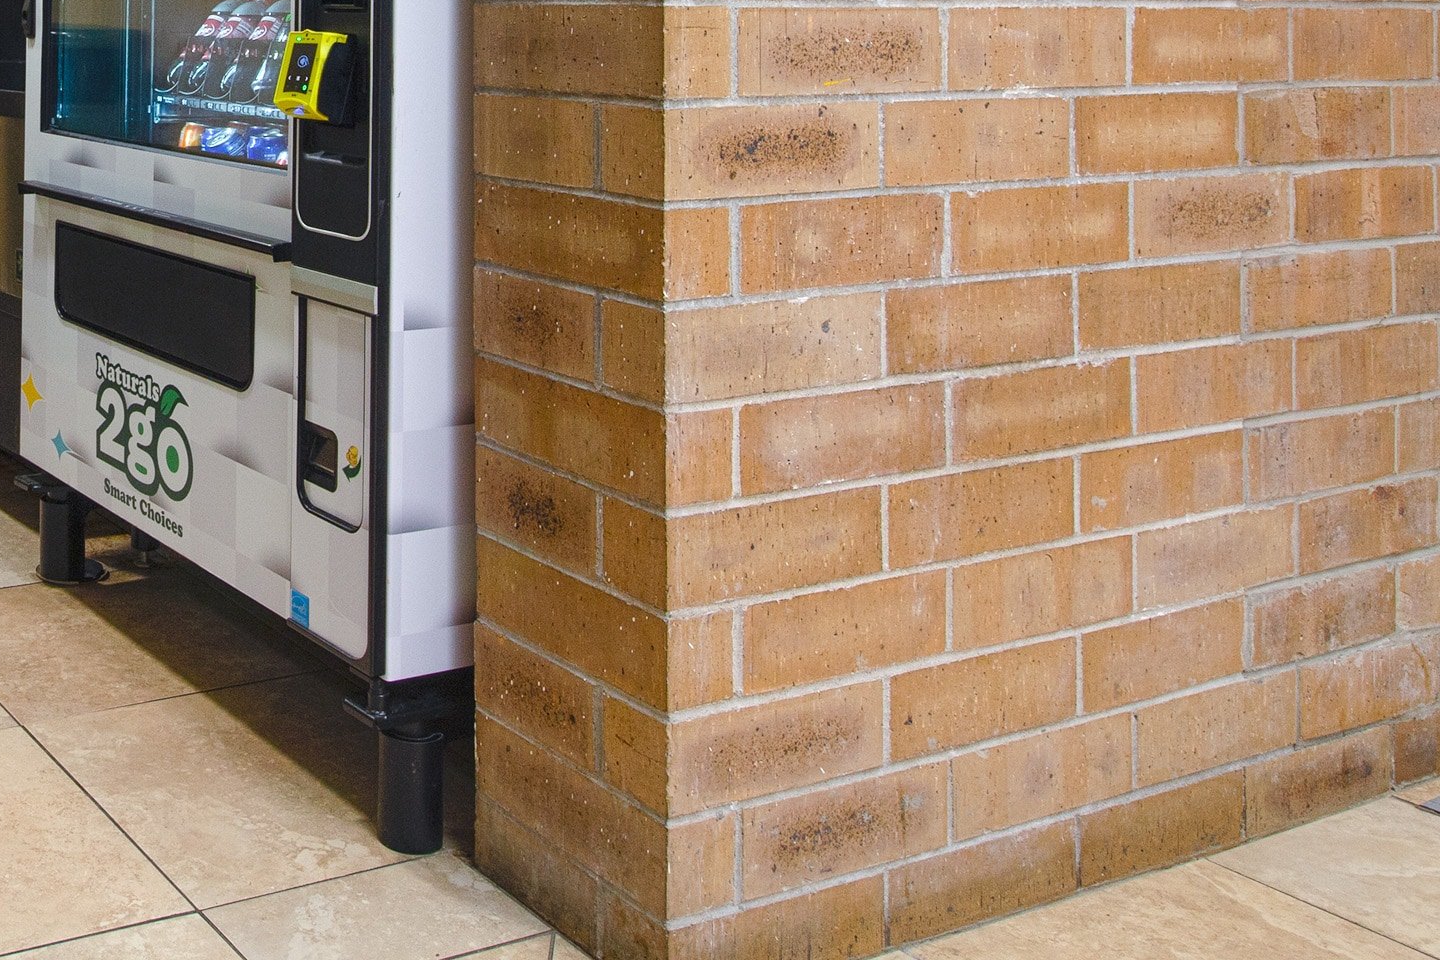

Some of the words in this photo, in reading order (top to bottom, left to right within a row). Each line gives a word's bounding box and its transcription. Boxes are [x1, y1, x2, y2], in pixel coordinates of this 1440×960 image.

[95, 352, 161, 403] Naturals
[103, 477, 138, 510] Smart
[139, 500, 184, 538] Choices
